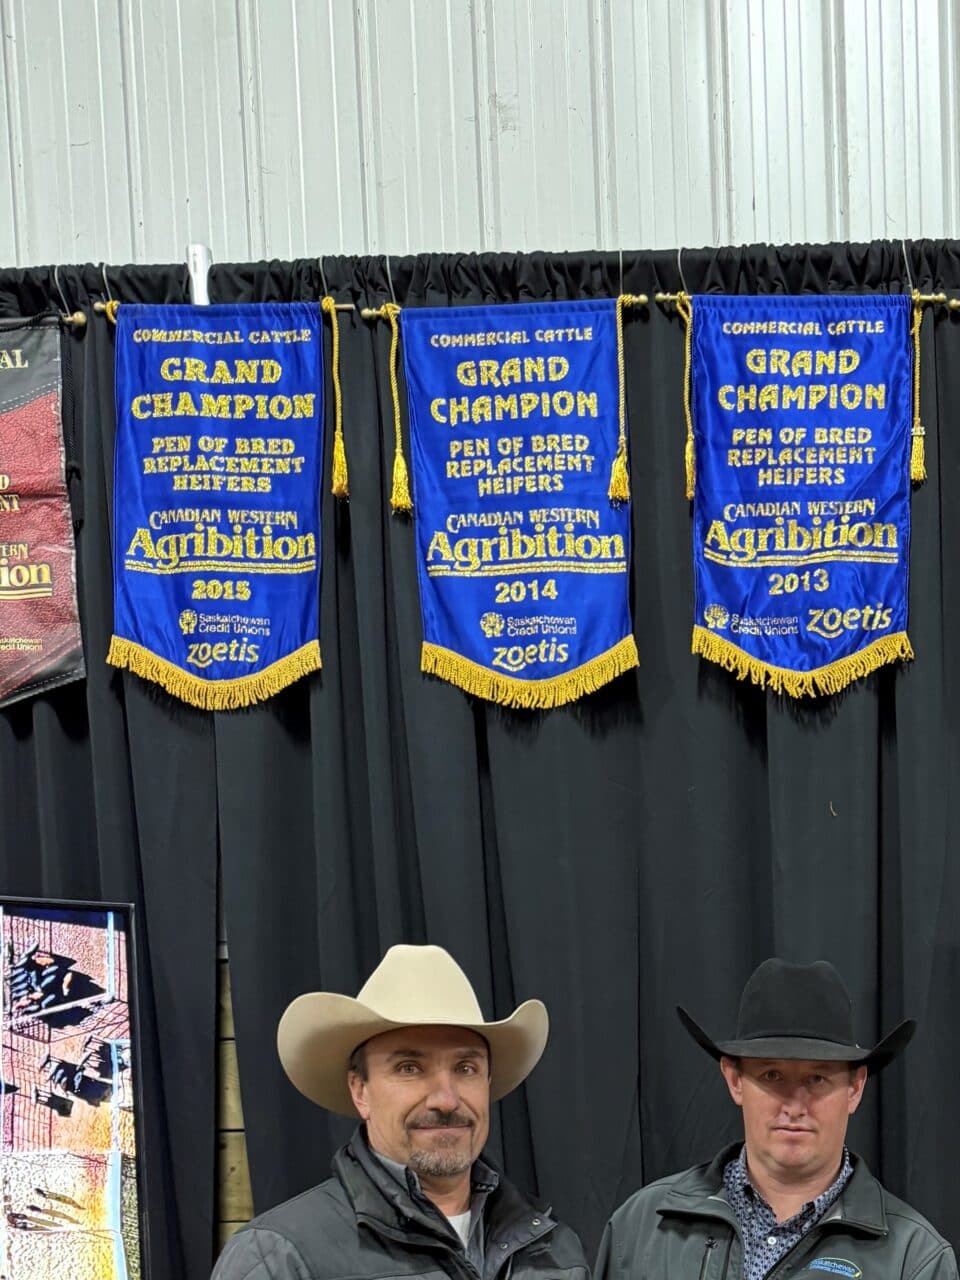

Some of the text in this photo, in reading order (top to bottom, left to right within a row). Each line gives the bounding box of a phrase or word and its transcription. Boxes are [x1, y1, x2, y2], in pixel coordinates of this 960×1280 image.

[133, 328, 311, 344] COMMERCIAL CATTLE
[430, 327, 593, 348] COMMERCIAL CATTLE
[722, 320, 885, 335] COMMERCIAL CATTLE
[160, 357, 282, 384] GRAND
[456, 356, 569, 388] GRAND
[746, 348, 860, 377] GRAND
[131, 392, 316, 420] CHAMPION
[430, 391, 598, 427] CHAMPION
[718, 383, 886, 413] CHAMPION
[152, 436, 295, 455] PEN OF BRED
[449, 434, 589, 458] PEN OF BRED
[732, 427, 872, 445] PEN OF BRED
[143, 455, 305, 474] REPLACEMENT
[446, 454, 595, 478] REPLACEMENT
[727, 447, 877, 467] REPLACEMENT
[173, 475, 272, 492] HEIFERS
[478, 474, 564, 497] HEIFERS
[758, 467, 846, 487] HEIFERS
[149, 508, 297, 530] CANADIAN WESTERN
[446, 508, 600, 533] CANADIAN WESTERN
[723, 498, 876, 523] CANADIAN WESTERN
[126, 523, 316, 568] Agribition
[427, 523, 625, 571] Agribition
[704, 515, 898, 561] Agribition
[191, 579, 251, 600] 2015
[495, 579, 558, 603] 2014
[768, 568, 829, 595] 2013
[806, 602, 893, 639] zoetis
[186, 637, 260, 667] zoetis
[492, 637, 569, 672] zoetis
